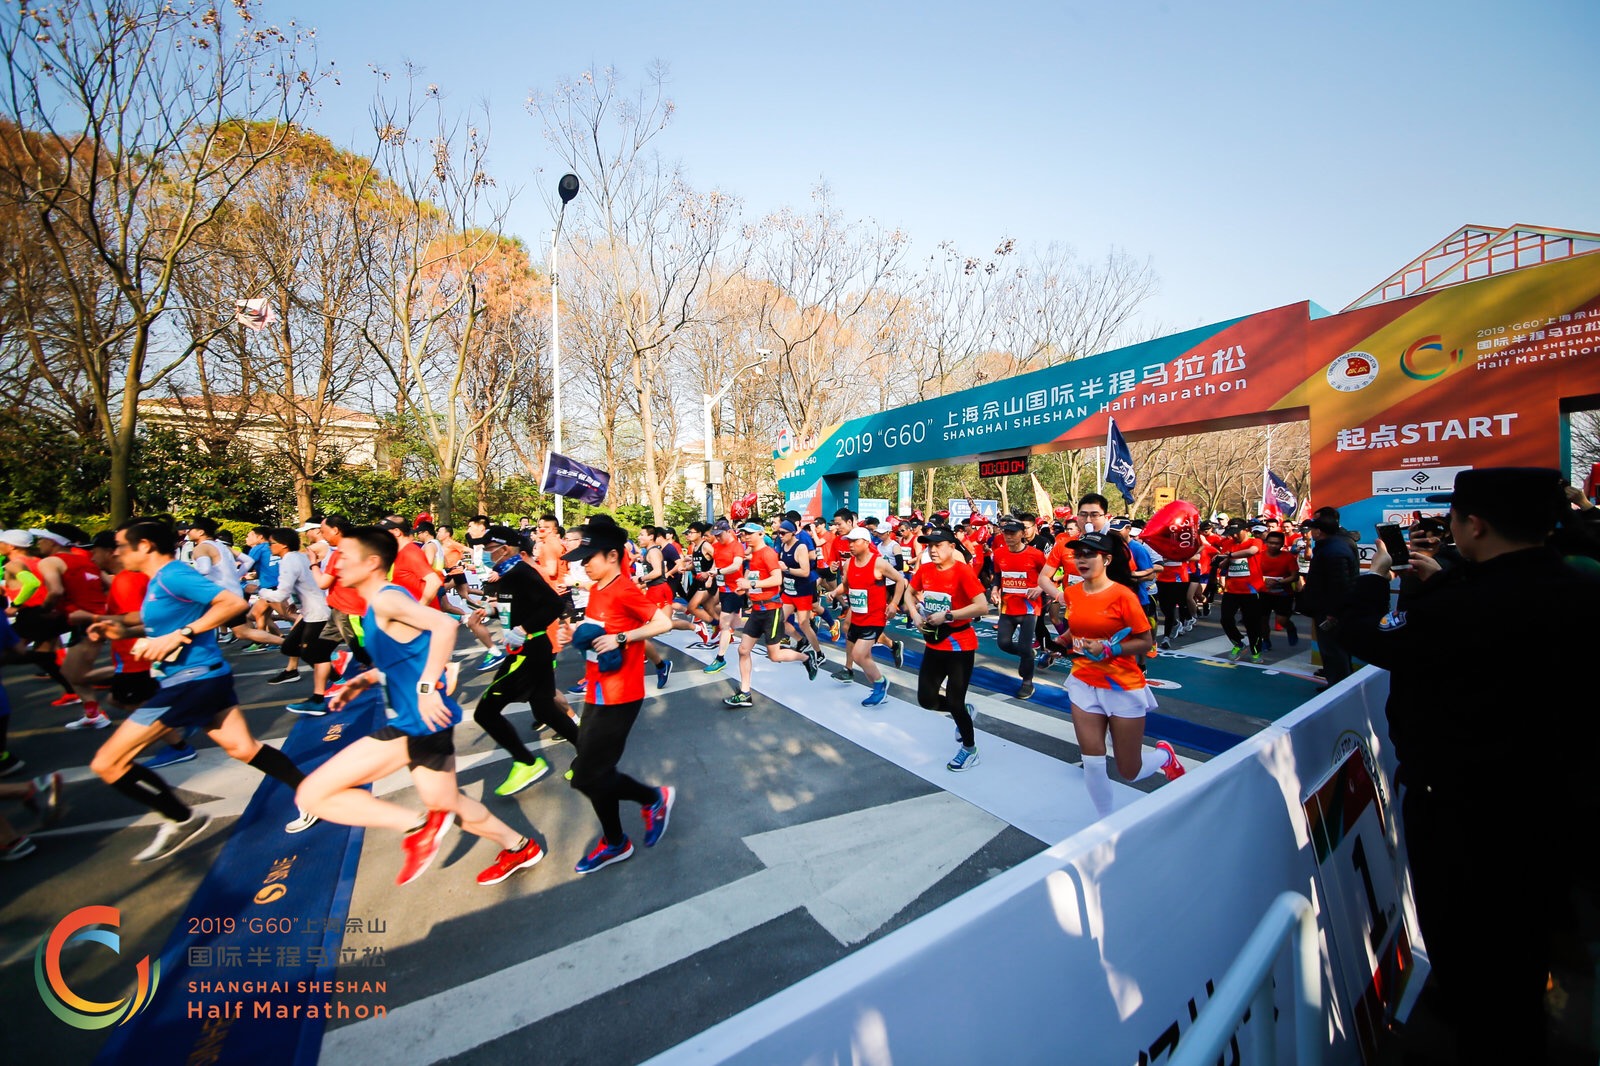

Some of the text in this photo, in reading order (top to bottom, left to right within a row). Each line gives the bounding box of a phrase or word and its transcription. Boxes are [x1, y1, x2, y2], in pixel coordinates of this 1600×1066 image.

[1477, 326, 1506, 338] 2019
[1478, 345, 1538, 360] SHANGHAI
[1477, 358, 1510, 370] Half
[835, 432, 873, 459] 2019
[943, 344, 1247, 429] 上海佘山国际半程马拉松
[943, 378, 1248, 441] SHANGHAI SHESHAN Half Marathon
